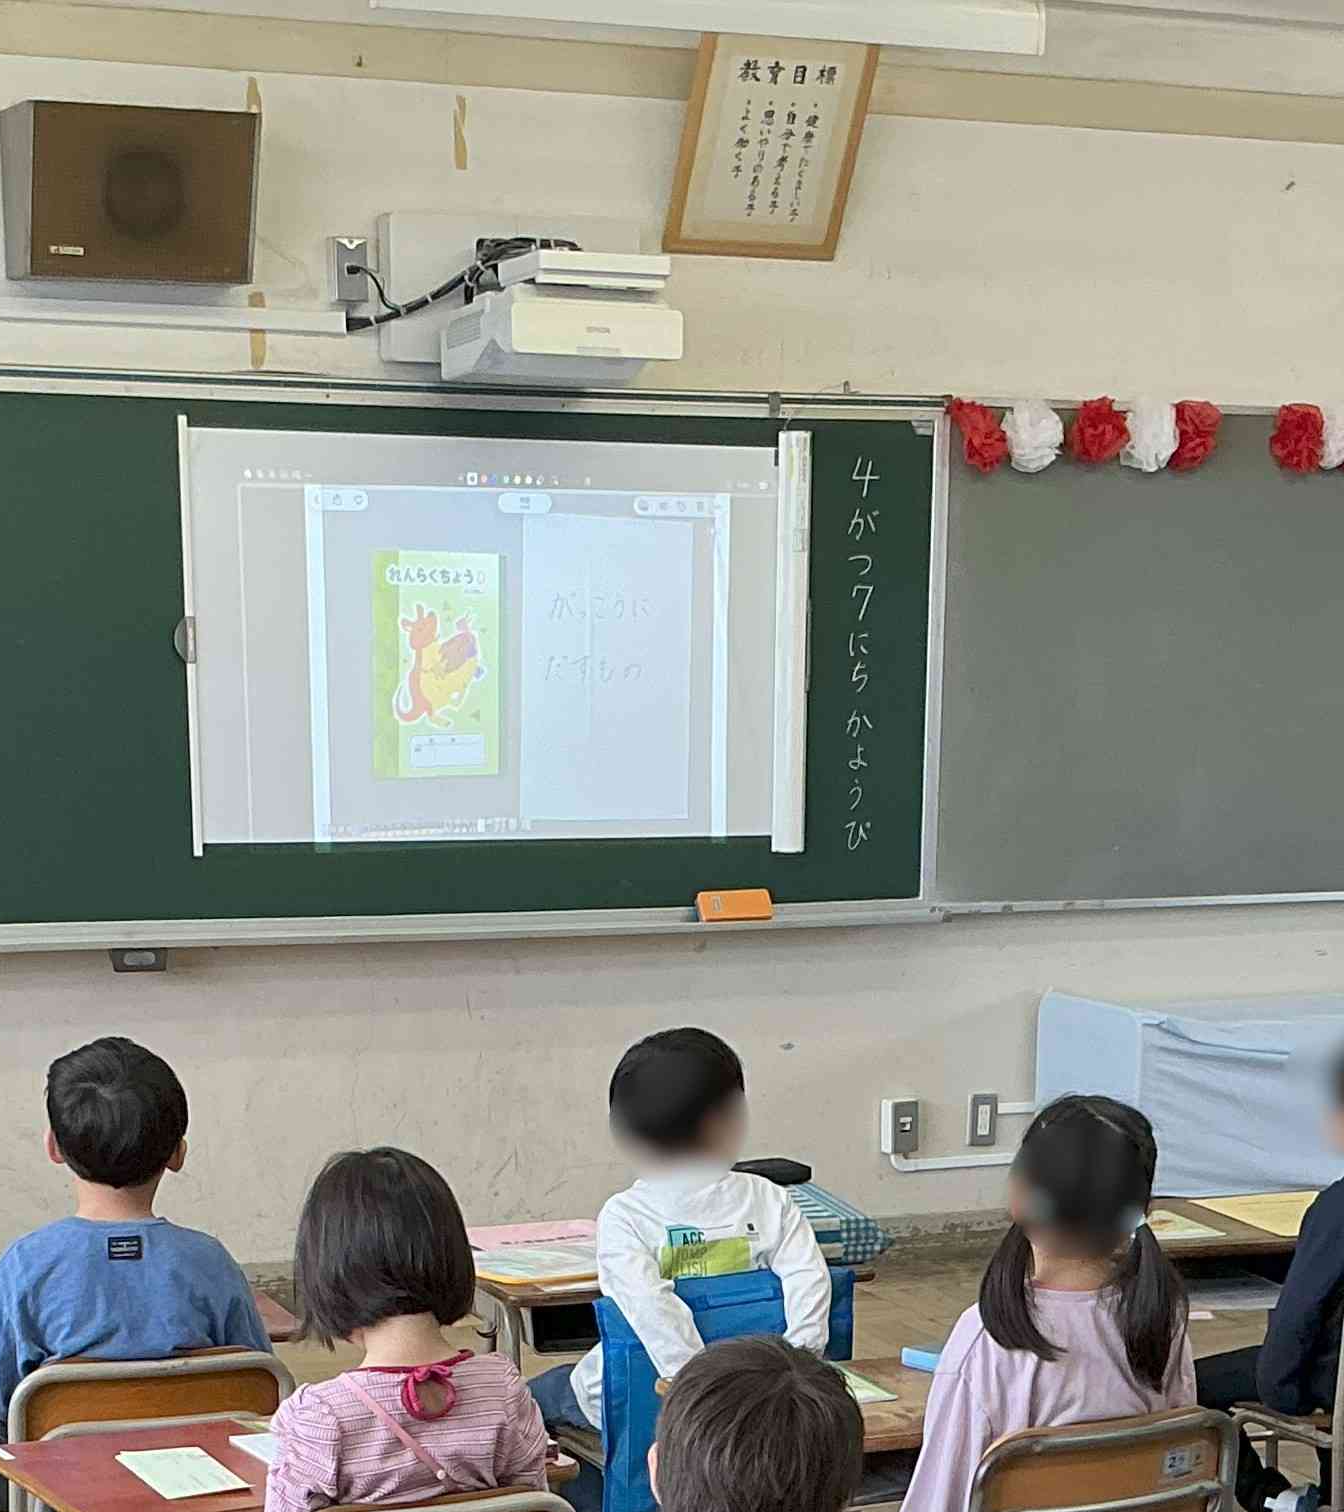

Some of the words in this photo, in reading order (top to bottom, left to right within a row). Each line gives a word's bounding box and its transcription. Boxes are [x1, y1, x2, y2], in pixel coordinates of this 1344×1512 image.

[737, 58, 840, 87] 教育目標
[682, 1231, 706, 1247] ACC
